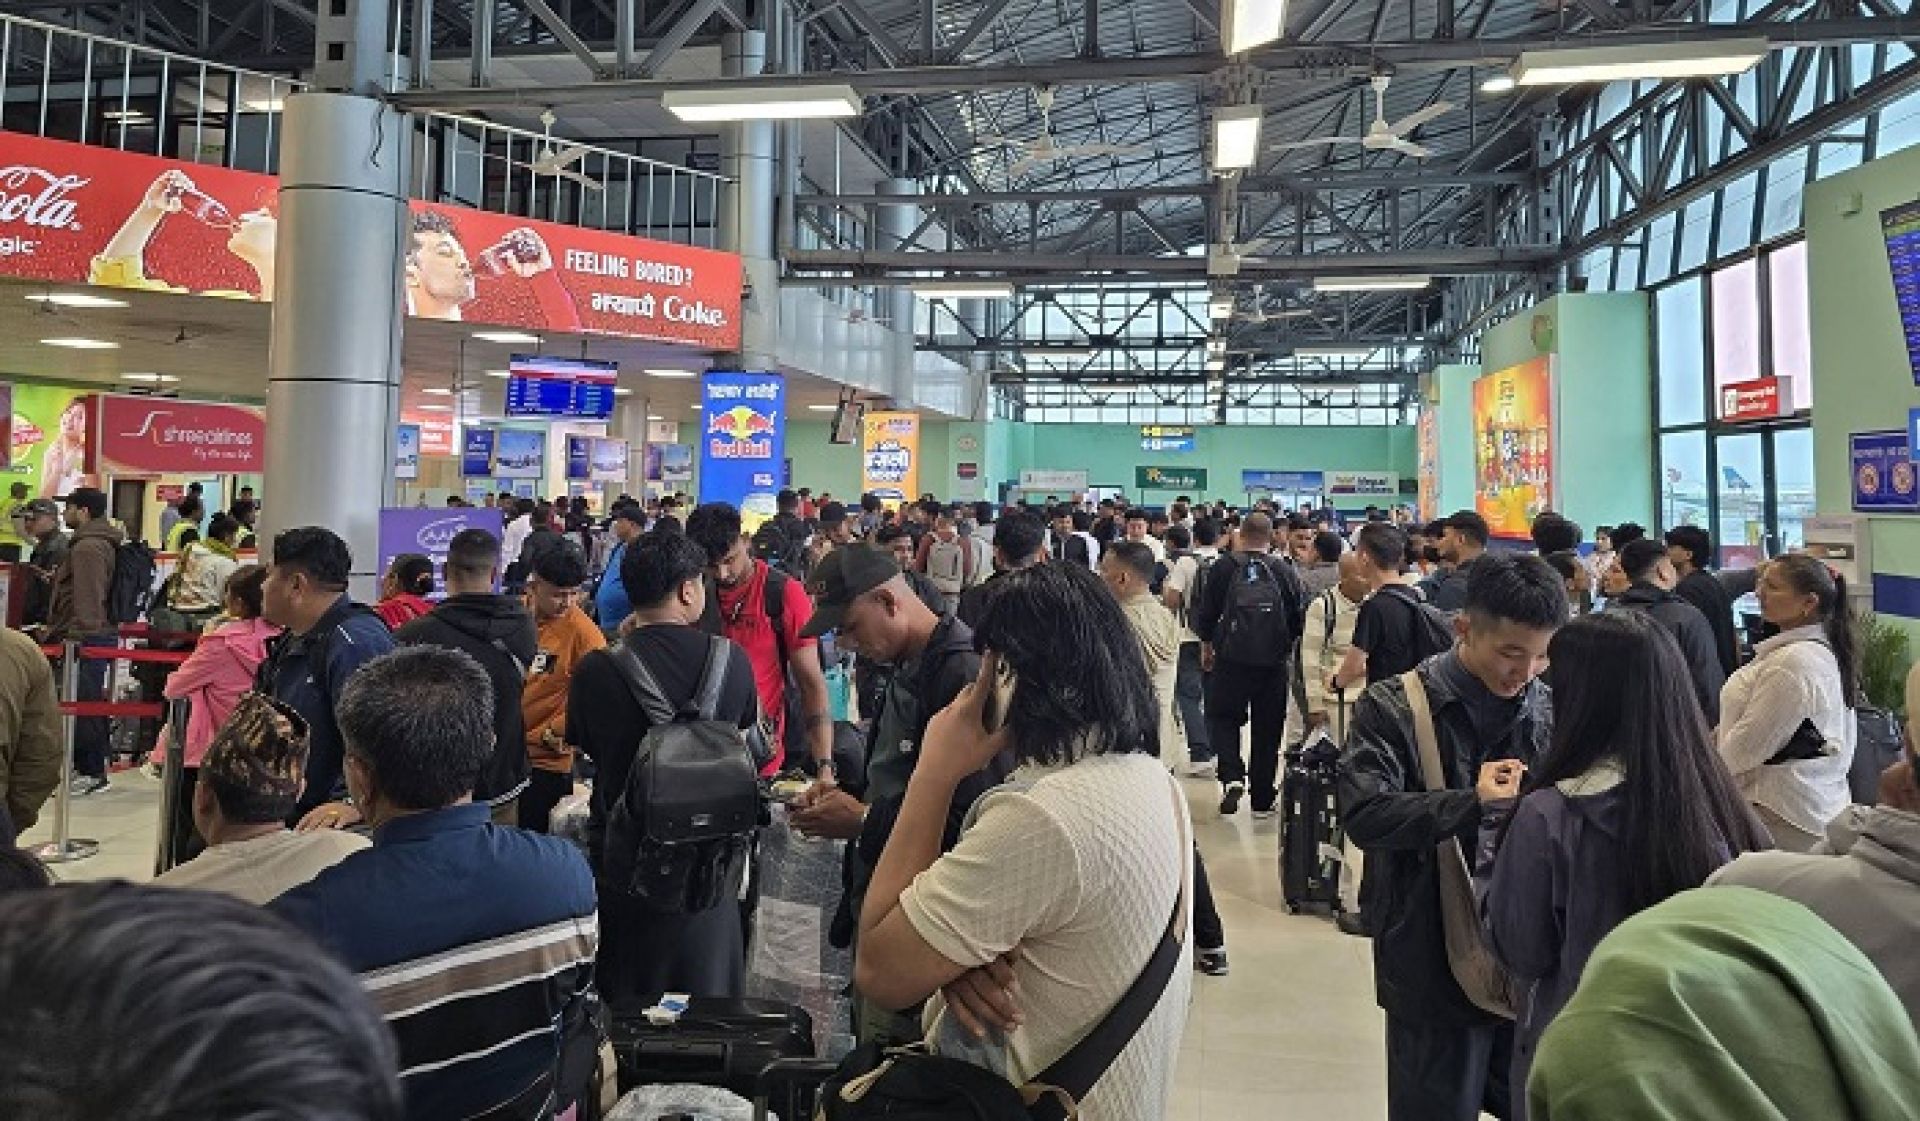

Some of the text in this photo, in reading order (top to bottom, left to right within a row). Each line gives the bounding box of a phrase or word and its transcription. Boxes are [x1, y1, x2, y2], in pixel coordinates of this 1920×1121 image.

[565, 248, 694, 288] FEELING BORED?
[709, 438, 772, 459] Red Bull
